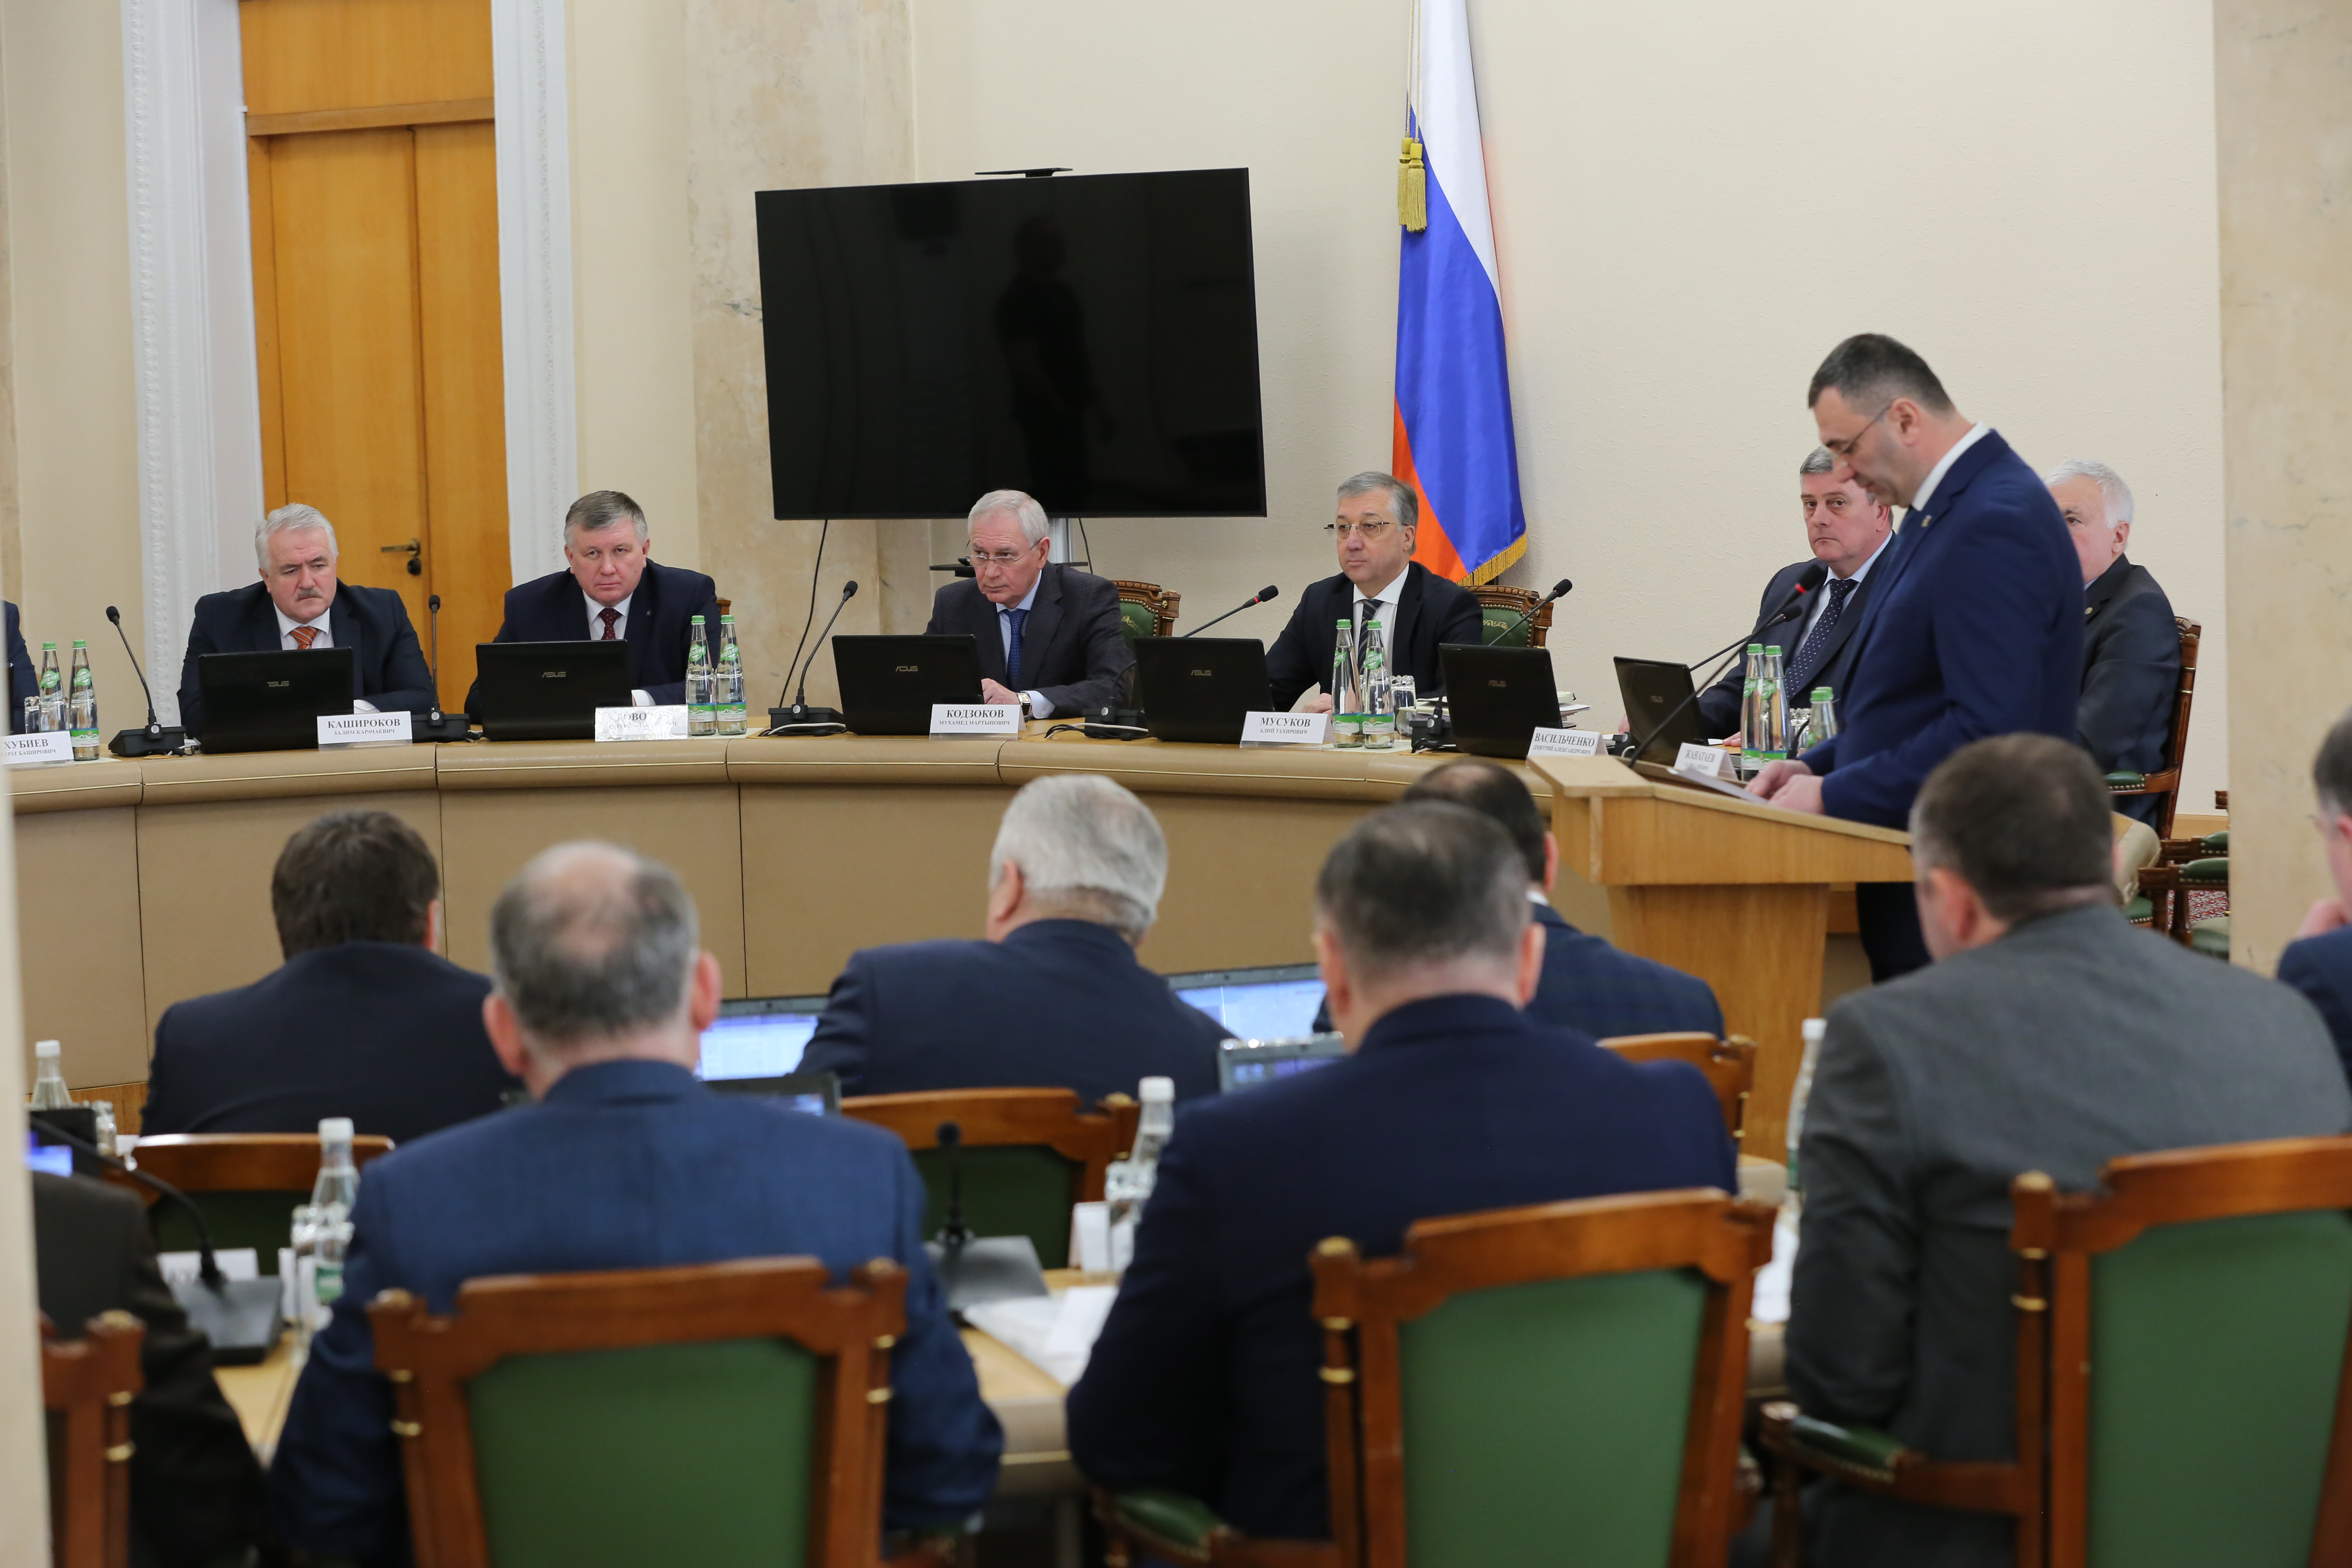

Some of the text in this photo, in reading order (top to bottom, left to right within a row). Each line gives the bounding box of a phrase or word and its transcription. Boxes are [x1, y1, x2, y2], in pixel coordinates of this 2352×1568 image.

[947, 710, 1004, 719] КОДЗОКОВ
[327, 719, 401, 728] КАШИРОКОВ
[1260, 717, 1311, 727] МУСУКОВ
[4, 739, 49, 749] ХУБИЕВ
[1534, 733, 1595, 747] ВАСИЛЬЧЕНКО
[1554, 747, 1591, 755] АЛЕКСАНДРОВИЧ
